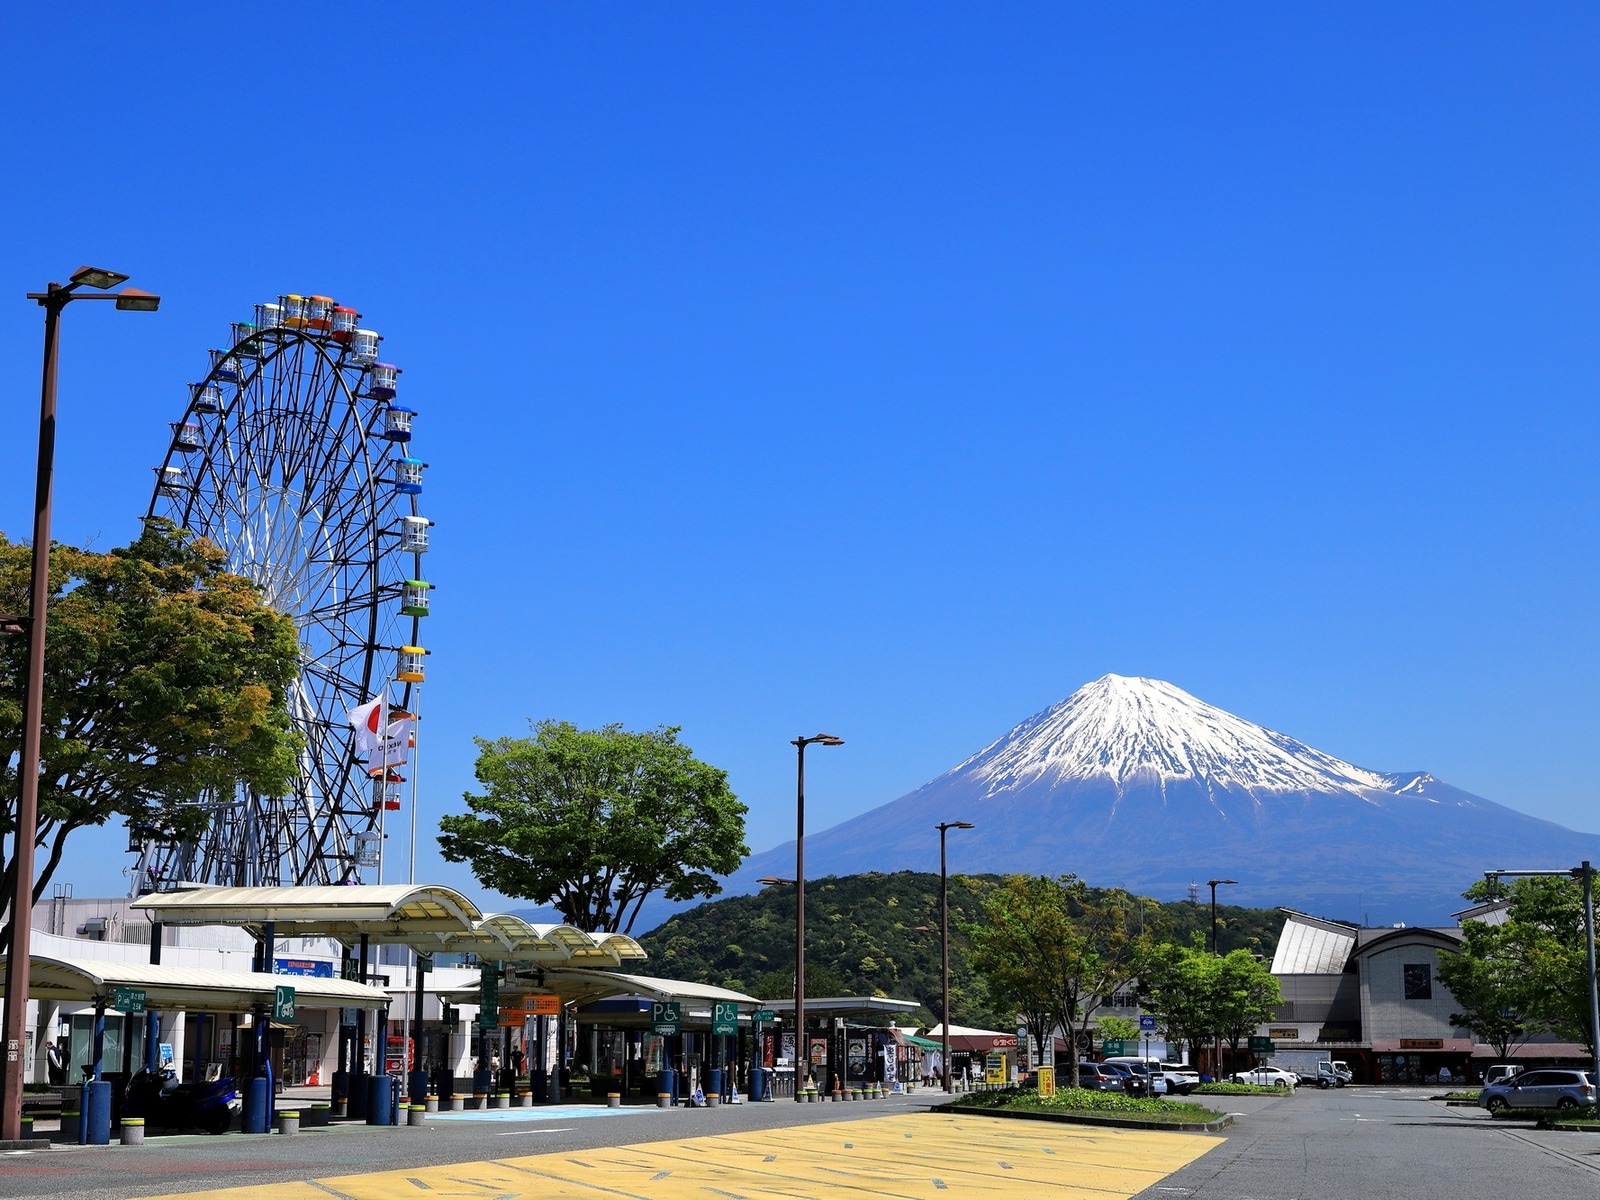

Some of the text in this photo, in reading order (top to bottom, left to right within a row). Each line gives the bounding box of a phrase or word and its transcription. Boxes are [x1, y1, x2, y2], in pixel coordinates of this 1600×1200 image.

[117, 994, 122, 1005] P
[276, 988, 284, 1018] P
[653, 1004, 663, 1021] P
[715, 1004, 724, 1021] P
[1000, 1038, 1017, 1046] 宝くじ
